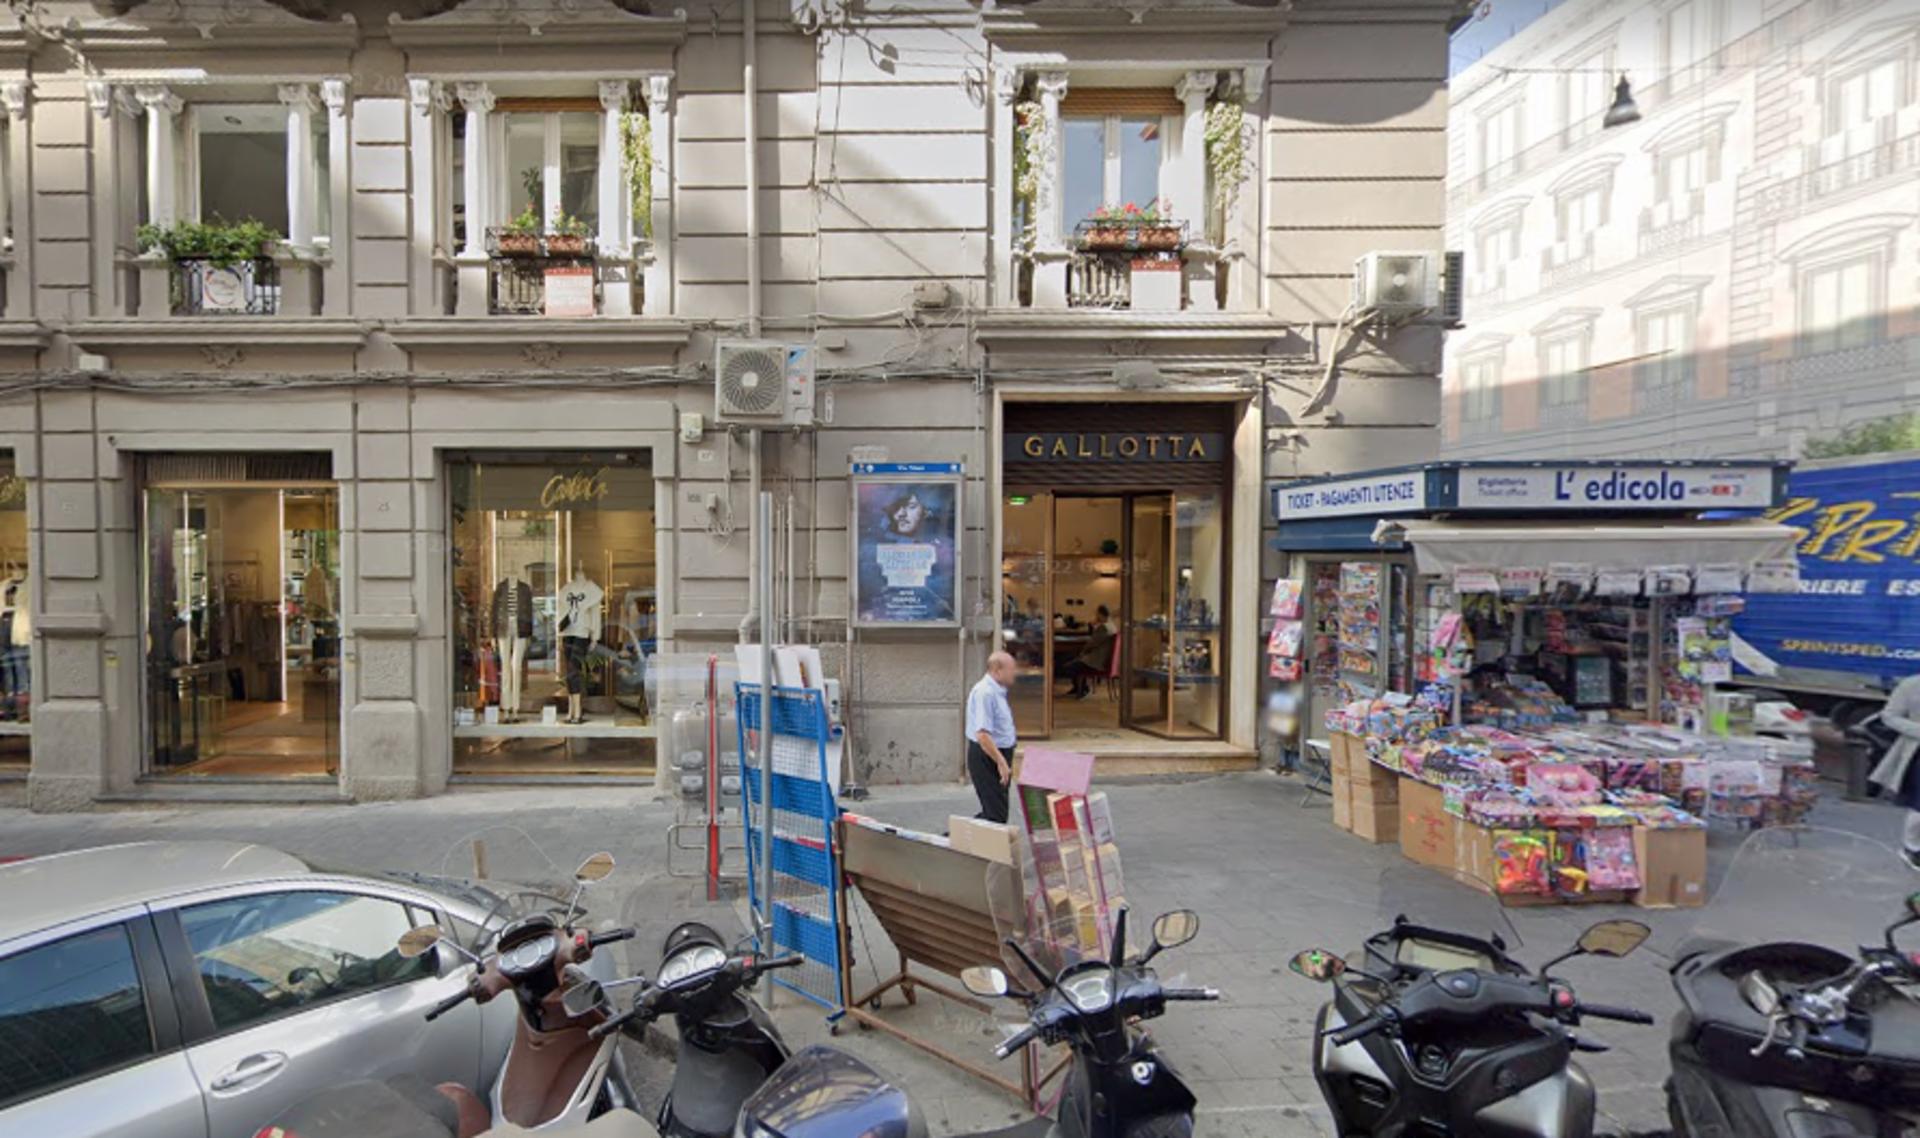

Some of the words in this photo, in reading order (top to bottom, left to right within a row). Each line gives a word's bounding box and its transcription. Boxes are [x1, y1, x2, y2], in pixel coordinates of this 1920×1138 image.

[1024, 435, 1206, 458] GALLOTTA
[1288, 493, 1314, 509] TICKET
[1321, 486, 1371, 507] PAGAMENTI
[1375, 480, 1415, 501] UTENZE
[1556, 470, 1575, 500] L'
[1585, 469, 1686, 501] edicola
